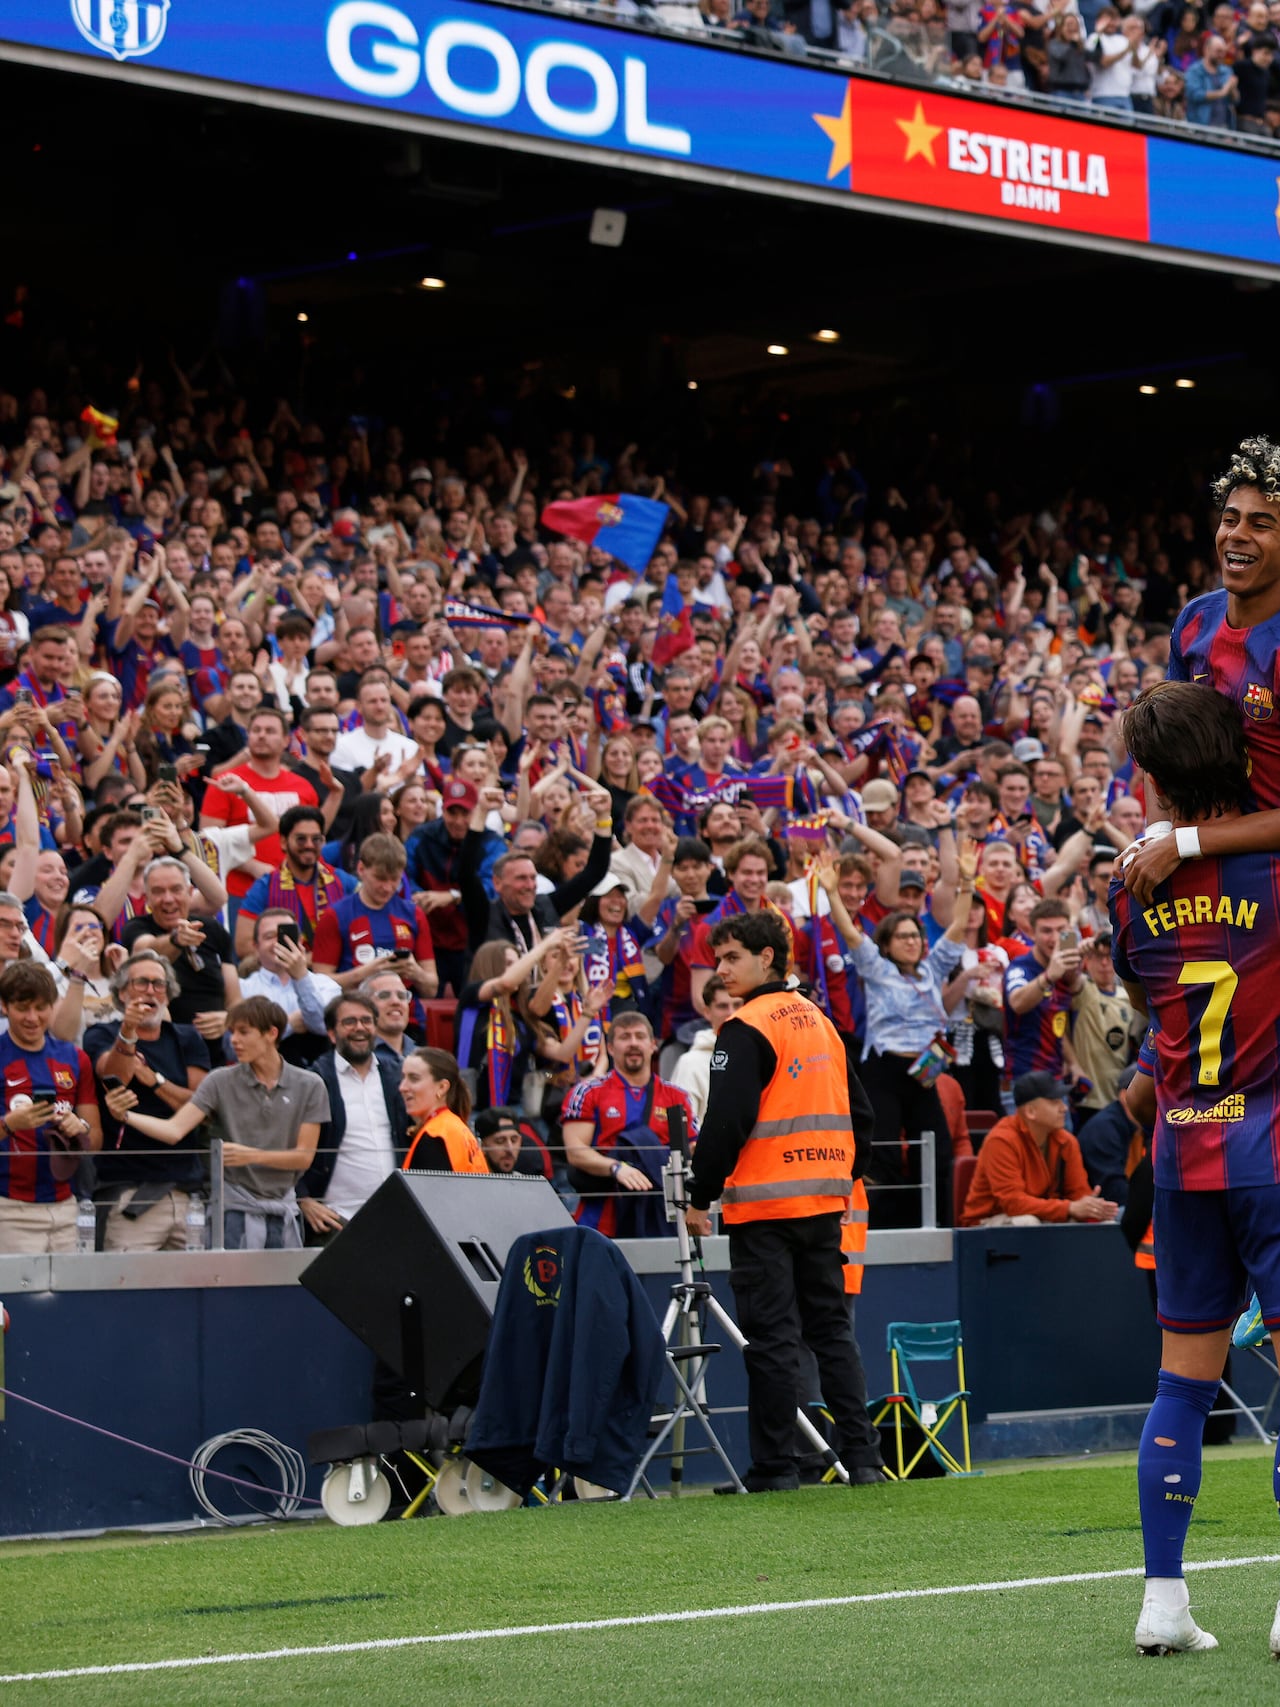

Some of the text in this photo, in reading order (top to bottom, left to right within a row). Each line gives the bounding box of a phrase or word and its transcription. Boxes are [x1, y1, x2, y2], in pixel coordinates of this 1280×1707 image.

[327, 1, 691, 154] GOOL
[948, 127, 1109, 197] ESTRELLA
[1001, 181, 1060, 214] DAMM
[1142, 895, 1259, 937] FERRAN
[1176, 960, 1239, 1086] 7
[783, 1147, 846, 1164] STEWARD
